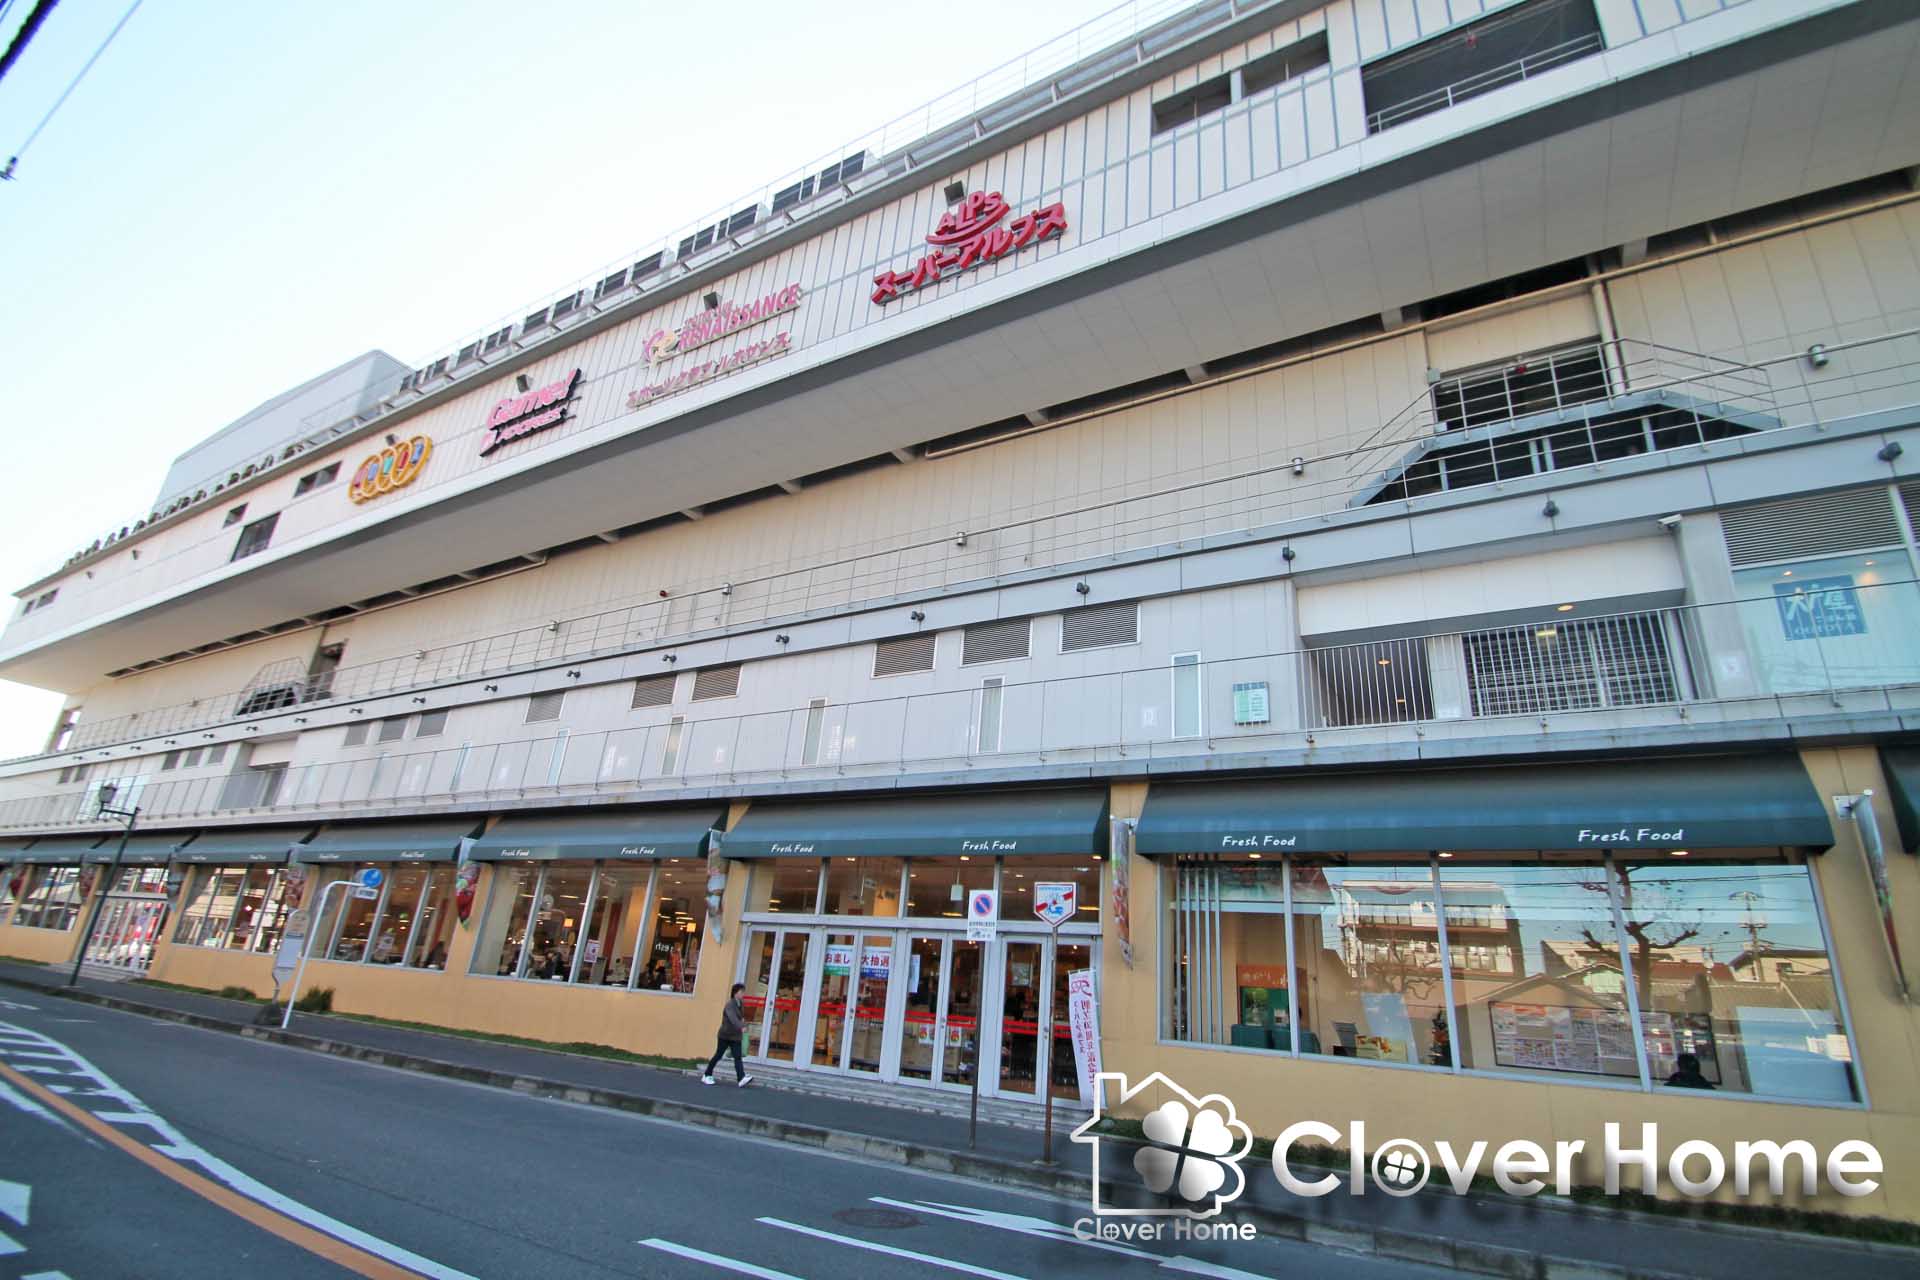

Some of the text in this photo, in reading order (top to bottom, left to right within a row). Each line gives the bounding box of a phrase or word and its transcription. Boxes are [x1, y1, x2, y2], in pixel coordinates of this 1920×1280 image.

[935, 190, 1005, 236] ALPS
[871, 202, 1068, 304] スーパーアルプス
[677, 282, 800, 350] RENAISSANCE
[1222, 834, 1297, 847] Fresh Food
[1577, 827, 1685, 843] Fresh Food
[770, 843, 815, 853] Fresh Food
[962, 840, 1017, 851] Fresh Food
